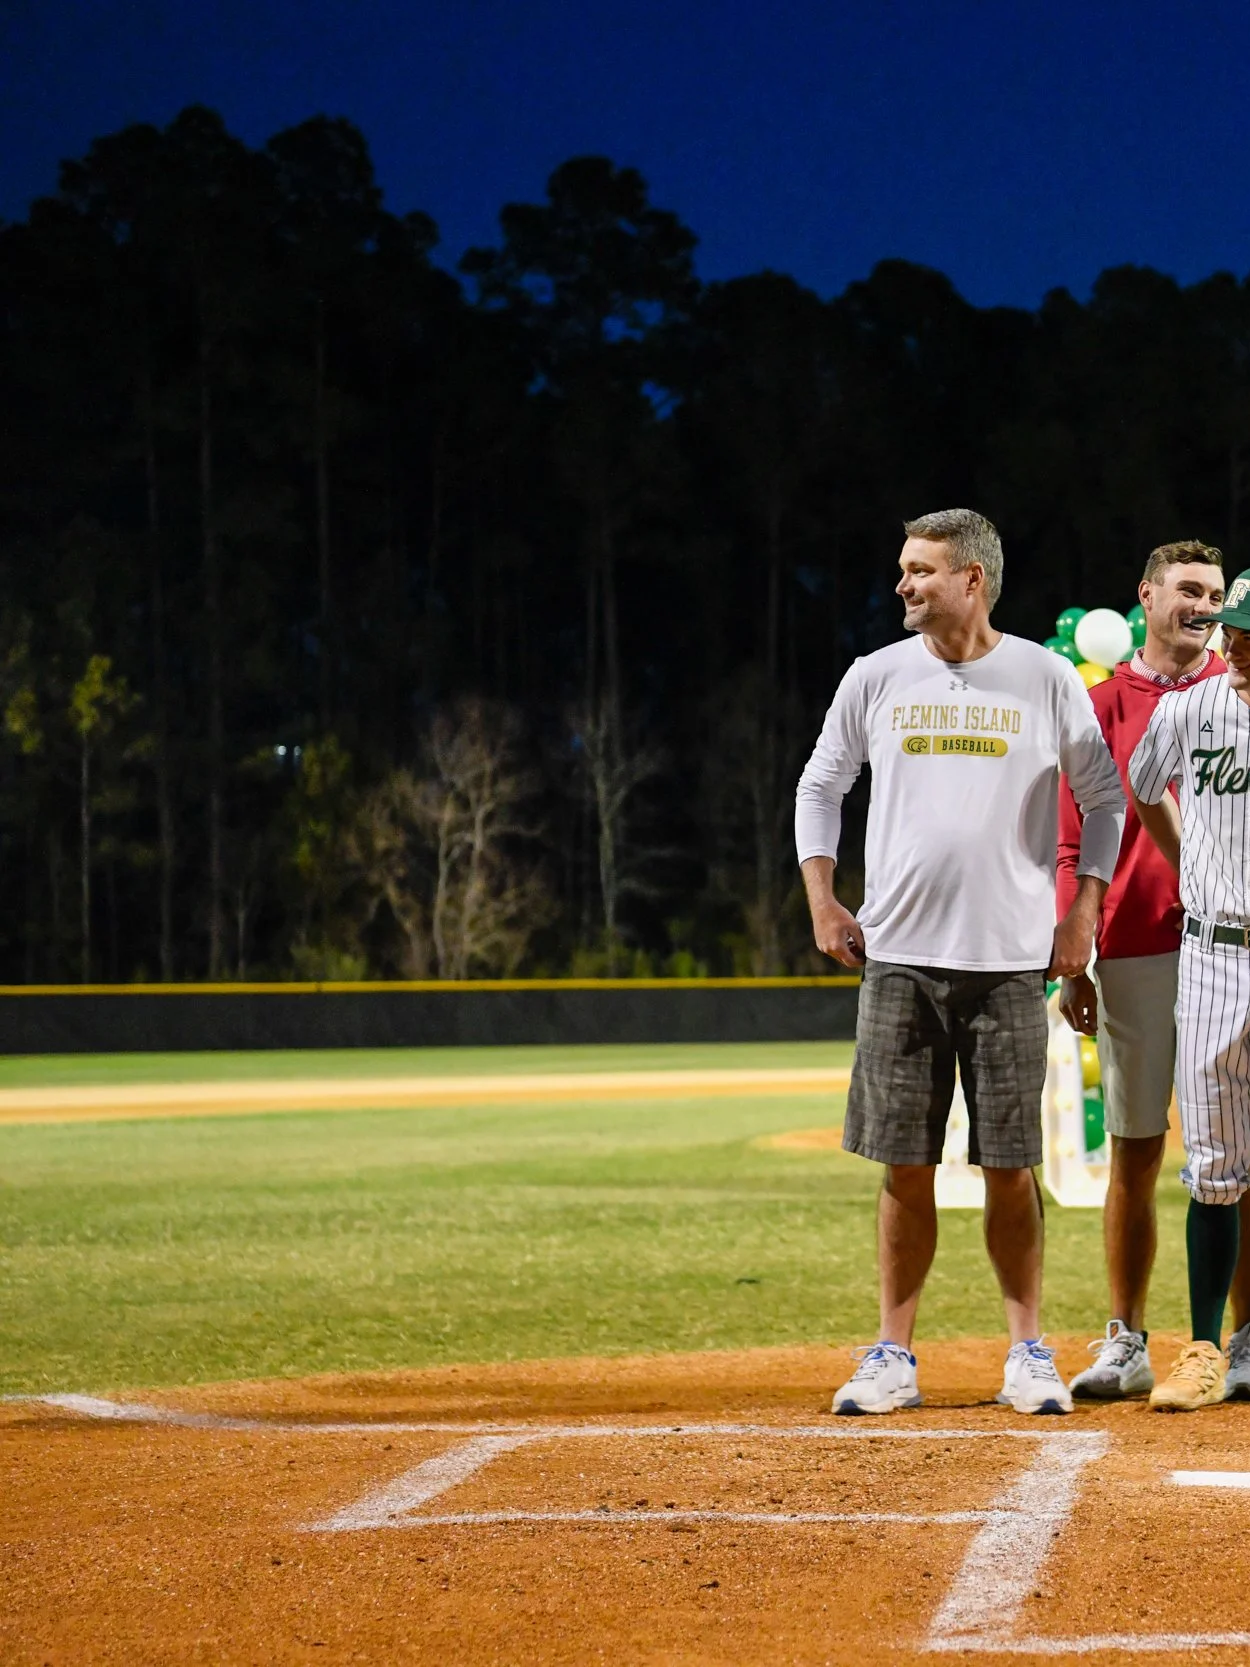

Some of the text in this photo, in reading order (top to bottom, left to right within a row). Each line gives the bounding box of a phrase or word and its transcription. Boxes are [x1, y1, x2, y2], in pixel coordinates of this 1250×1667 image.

[892, 705, 1021, 734] FLEMING ISLAND
[942, 739, 996, 753] BASEBALL
